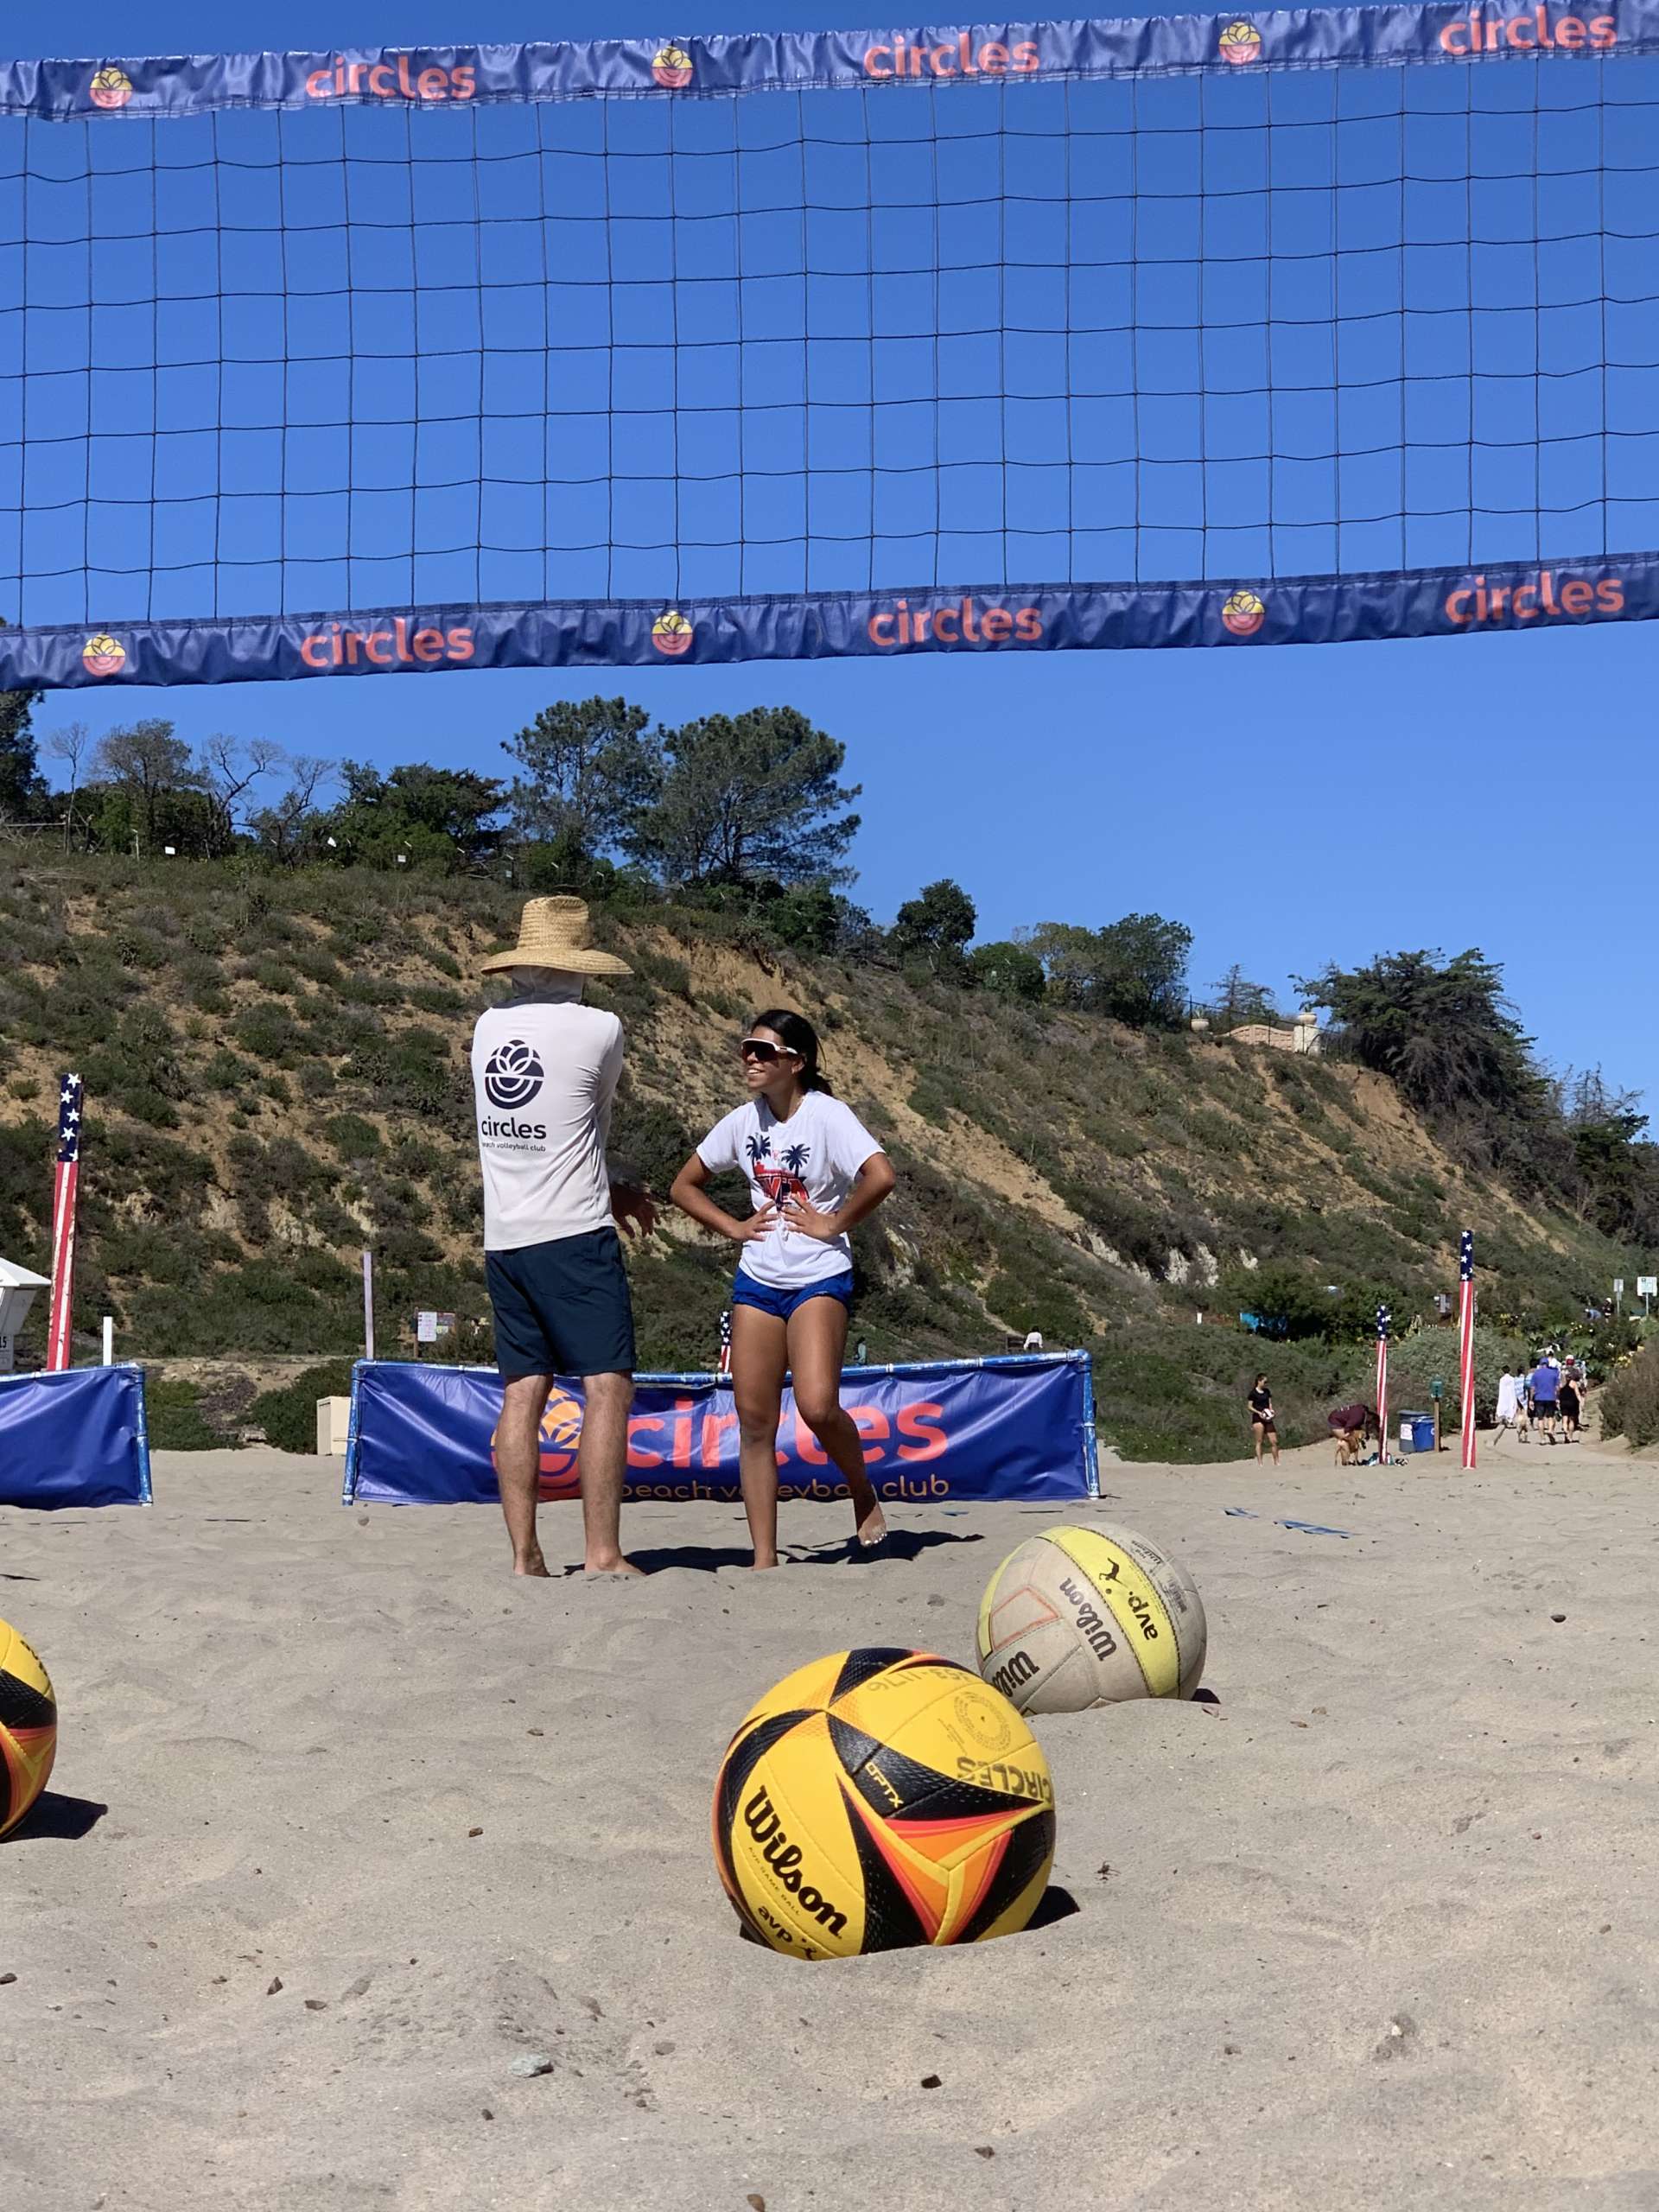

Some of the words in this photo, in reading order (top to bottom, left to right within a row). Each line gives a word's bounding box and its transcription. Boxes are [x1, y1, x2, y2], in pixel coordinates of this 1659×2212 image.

[1440, 5, 1618, 55] circles
[306, 54, 477, 101] circles
[863, 32, 1041, 79] circles
[868, 596, 1043, 647] circles
[1444, 570, 1624, 623] circles
[301, 617, 475, 669] circles
[481, 1115, 547, 1139] circles
[626, 1397, 948, 1467] cirles
[882, 1473, 950, 1497] club
[1059, 1577, 1117, 1662] Wilson
[864, 1761, 904, 1808] OPTX
[957, 1757, 1053, 1804] CIRCLES
[744, 1784, 848, 1938] Wilson
